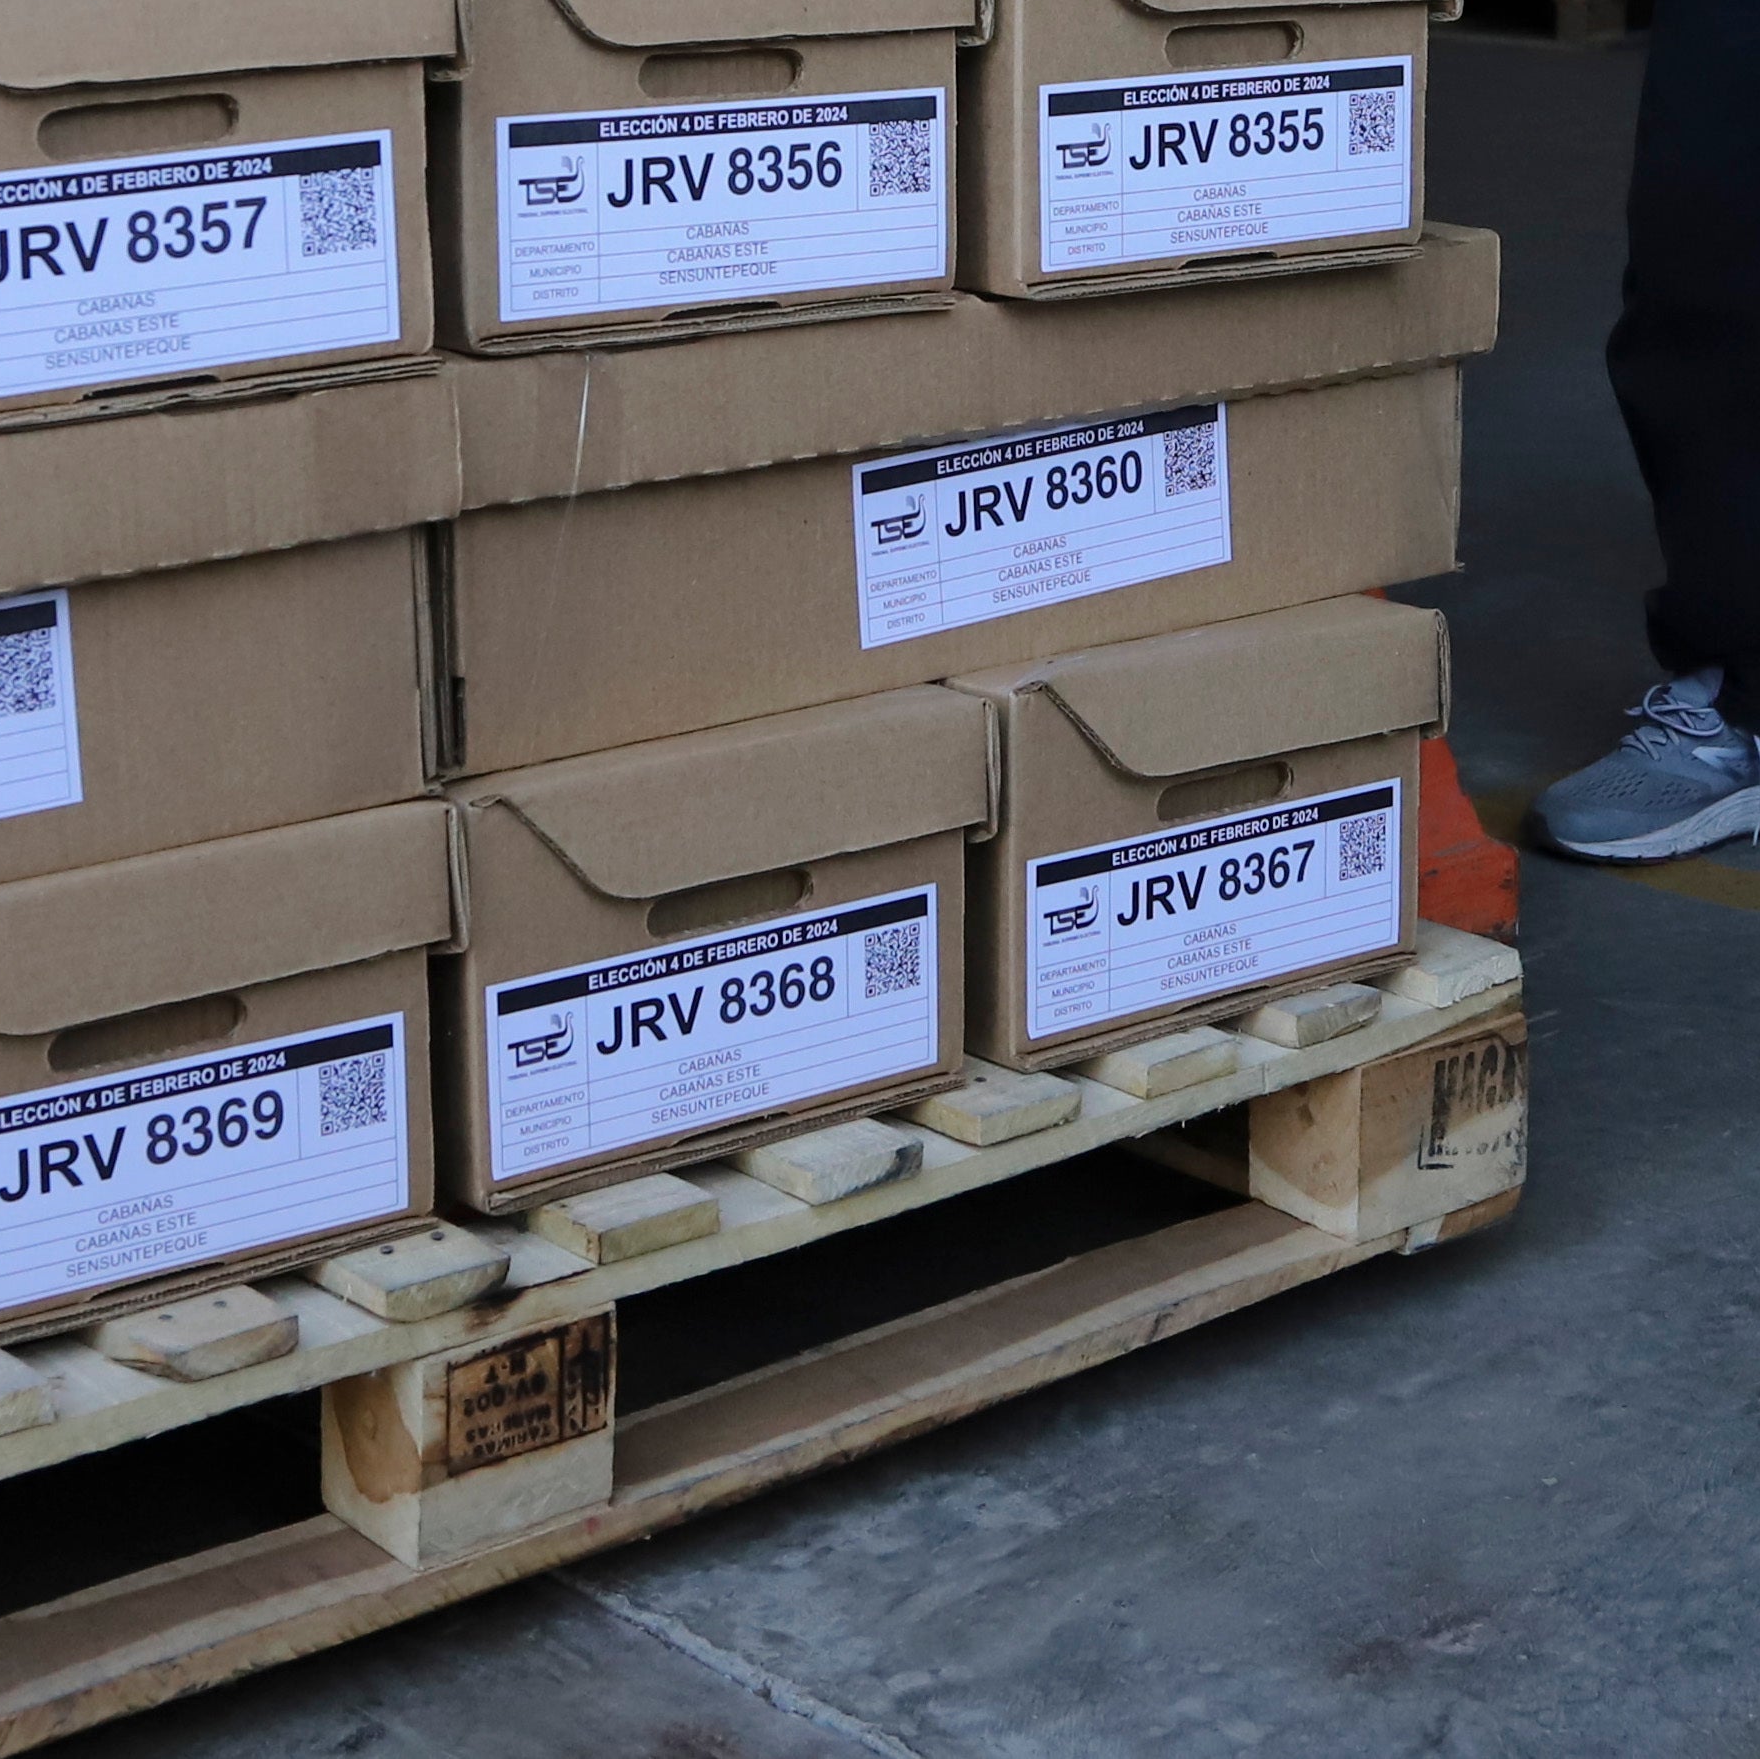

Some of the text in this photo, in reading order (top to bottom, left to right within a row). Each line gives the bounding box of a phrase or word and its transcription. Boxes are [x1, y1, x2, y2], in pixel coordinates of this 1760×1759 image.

[1123, 73, 1330, 107] ELECCIÓN 4 DE FEBRERO DE 2024
[1128, 106, 1324, 170] JRV 8355
[606, 139, 842, 208] JRV 8356
[1053, 200, 1119, 218] DEPARTAMENTO
[126, 195, 267, 263] 8357
[1065, 221, 1108, 236] MUNICIPIO
[734, 241, 769, 257] ESTE
[1067, 241, 1105, 256] DISTRITO
[659, 261, 777, 286] SENSUNTEPEQUE
[936, 420, 1144, 477] ELECCIÓN 4 DE FEBRERO DE 2024
[944, 449, 1142, 537] JRV 8360
[870, 568, 937, 594] DEPARTAMENTO
[883, 591, 926, 611] MUNICIPIO
[885, 611, 924, 630] DISTRITO
[1116, 838, 1315, 927] JRV 8367
[1223, 937, 1252, 956] ESTE
[1160, 954, 1258, 991] SENSUNTEPEQUE
[595, 955, 835, 1055] JRV 8368
[145, 1089, 284, 1165] 8369
[155, 1211, 197, 1234] ESTE
[66, 1231, 207, 1278] SENSUNTEPEQUE
